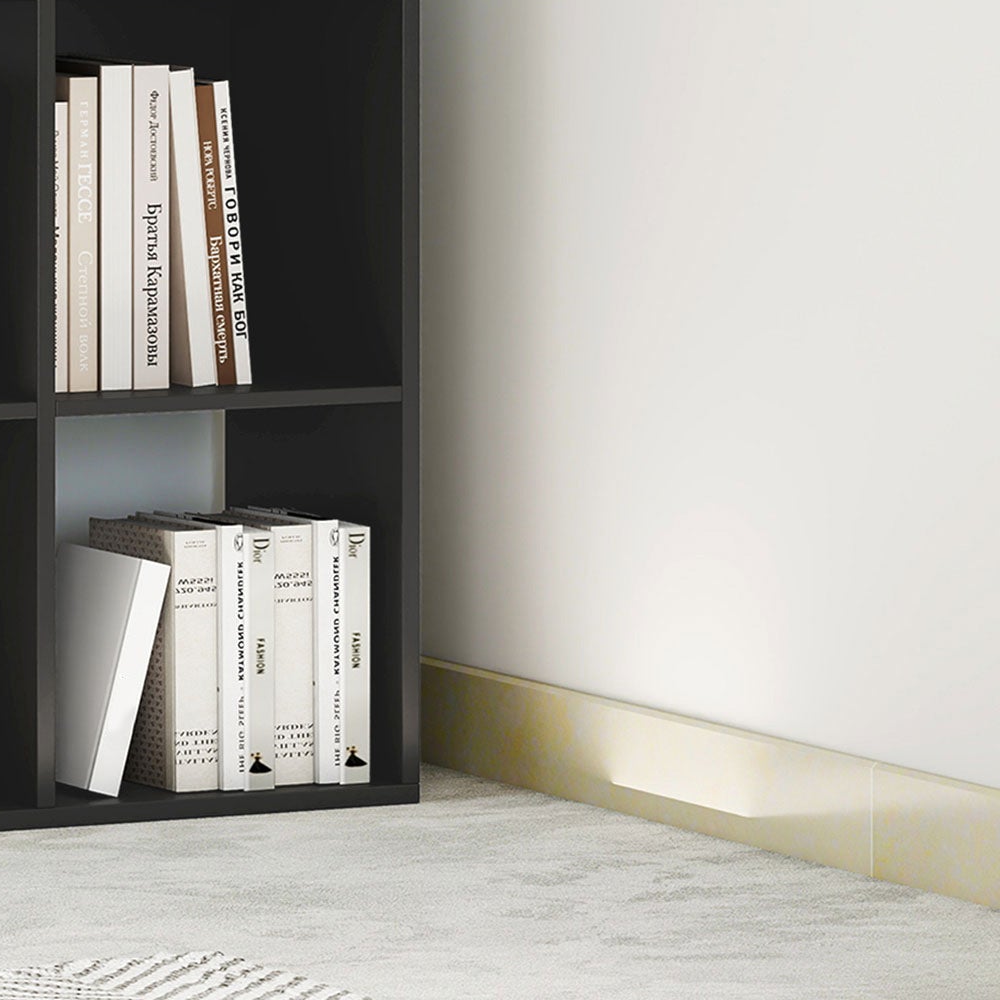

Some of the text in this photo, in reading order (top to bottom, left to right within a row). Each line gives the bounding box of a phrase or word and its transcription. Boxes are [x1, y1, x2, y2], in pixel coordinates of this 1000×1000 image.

[220, 107, 232, 179] КСЕНИЯ ЧЕРНОВА
[78, 163, 93, 224] ГЕССЕ
[78, 250, 93, 328] Степной
[142, 203, 162, 367] Братья Карамазовы
[224, 186, 247, 340] ГОВОРИ КАК БОГ
[208, 236, 228, 364] Бархатная смерть
[253, 538, 270, 563] Dior
[348, 533, 365, 558] Dior
[256, 638, 265, 675] FASHION
[351, 632, 361, 669] FASHION
